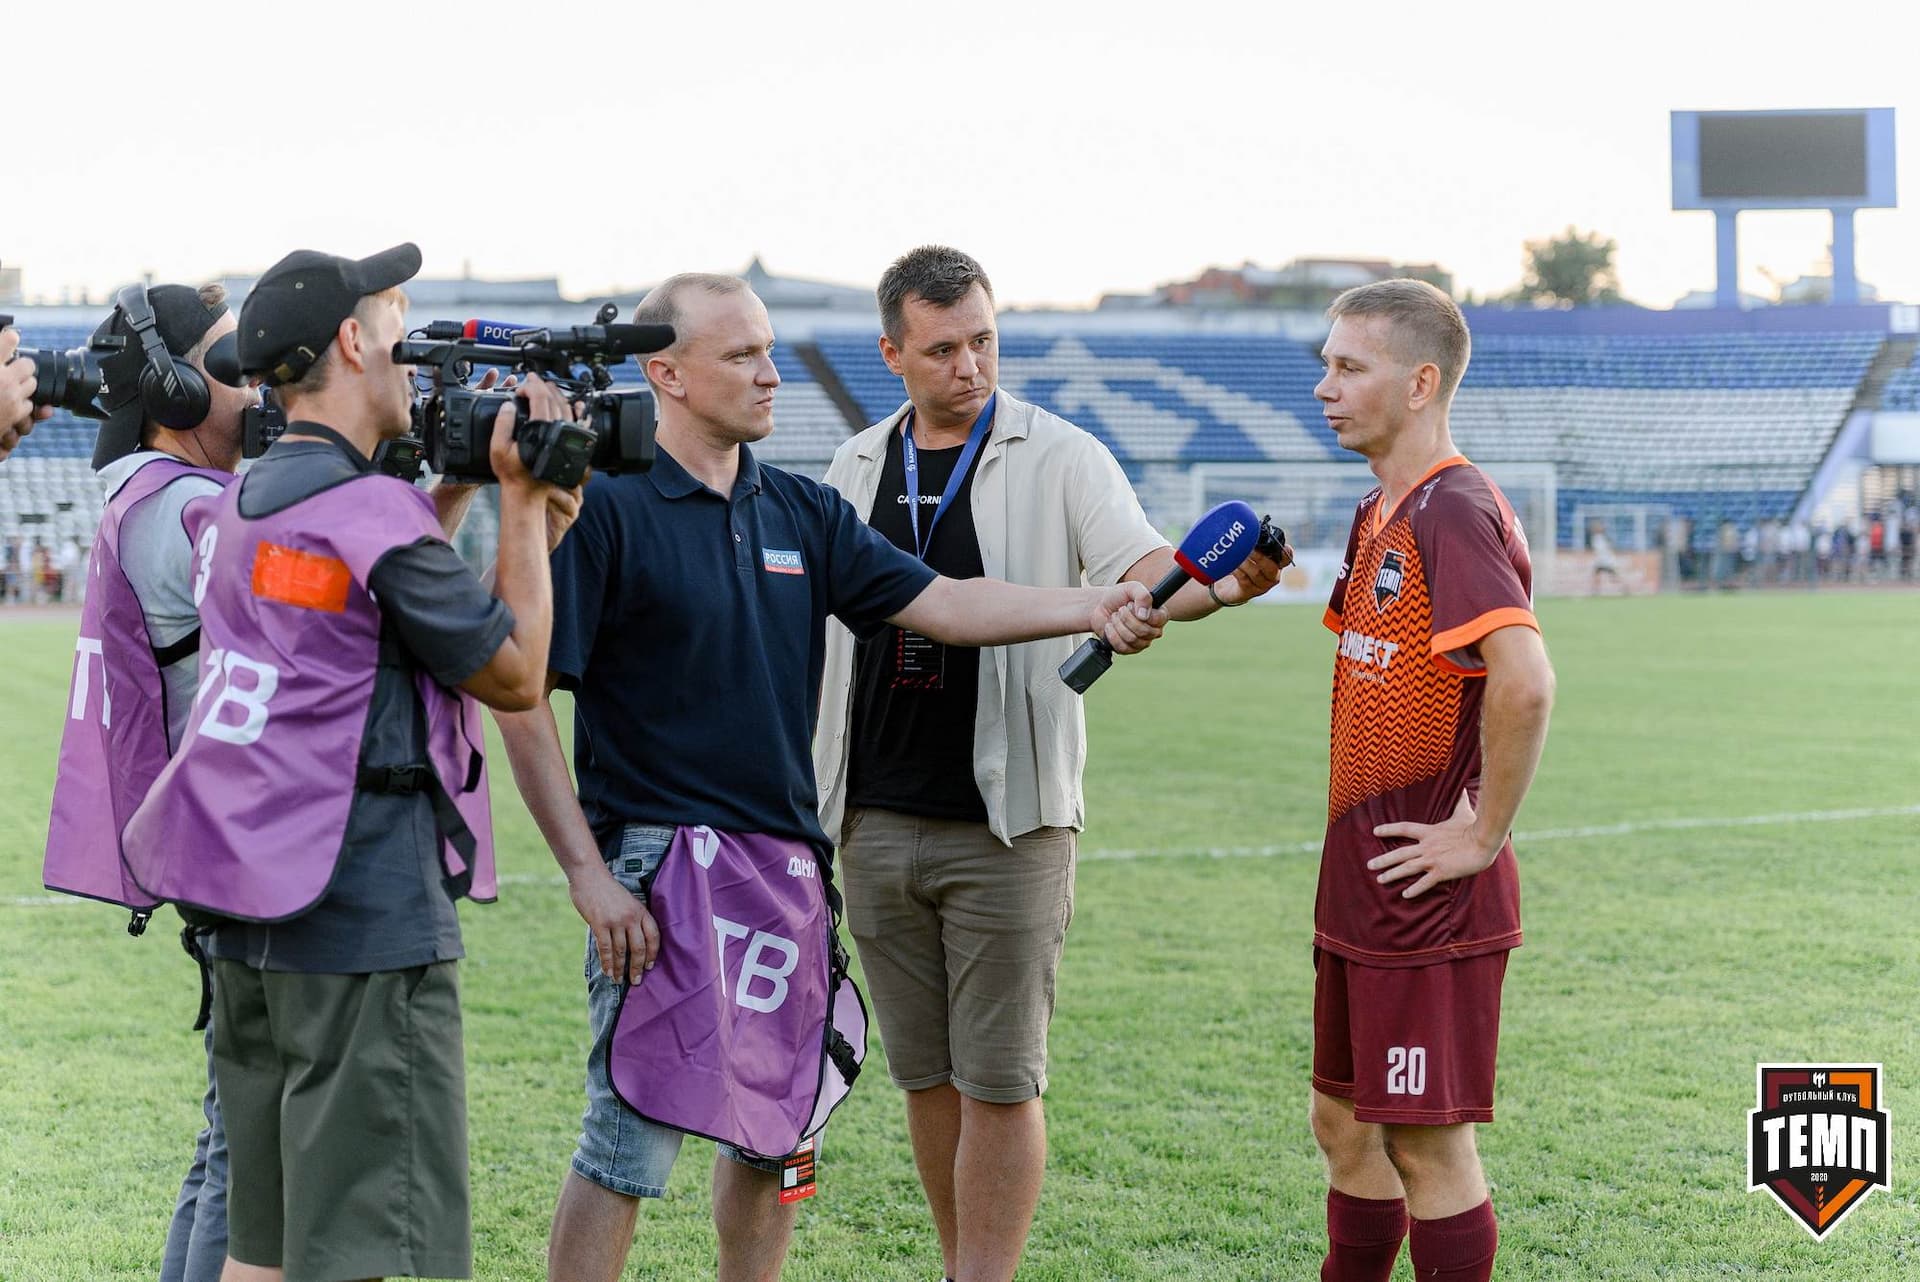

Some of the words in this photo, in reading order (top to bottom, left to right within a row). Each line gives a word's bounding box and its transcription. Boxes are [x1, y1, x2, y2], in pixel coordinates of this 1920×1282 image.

[483, 325, 511, 339] РОС
[897, 495, 942, 504] CAORNI
[765, 552, 799, 565] РОССИЯ
[1198, 520, 1245, 568] РОССИЯ
[1377, 568, 1401, 594] ТЕМП
[71, 637, 111, 729] Т
[197, 649, 279, 745] ТВ
[712, 914, 799, 1013] ТВ
[1387, 1047, 1425, 1095] 20
